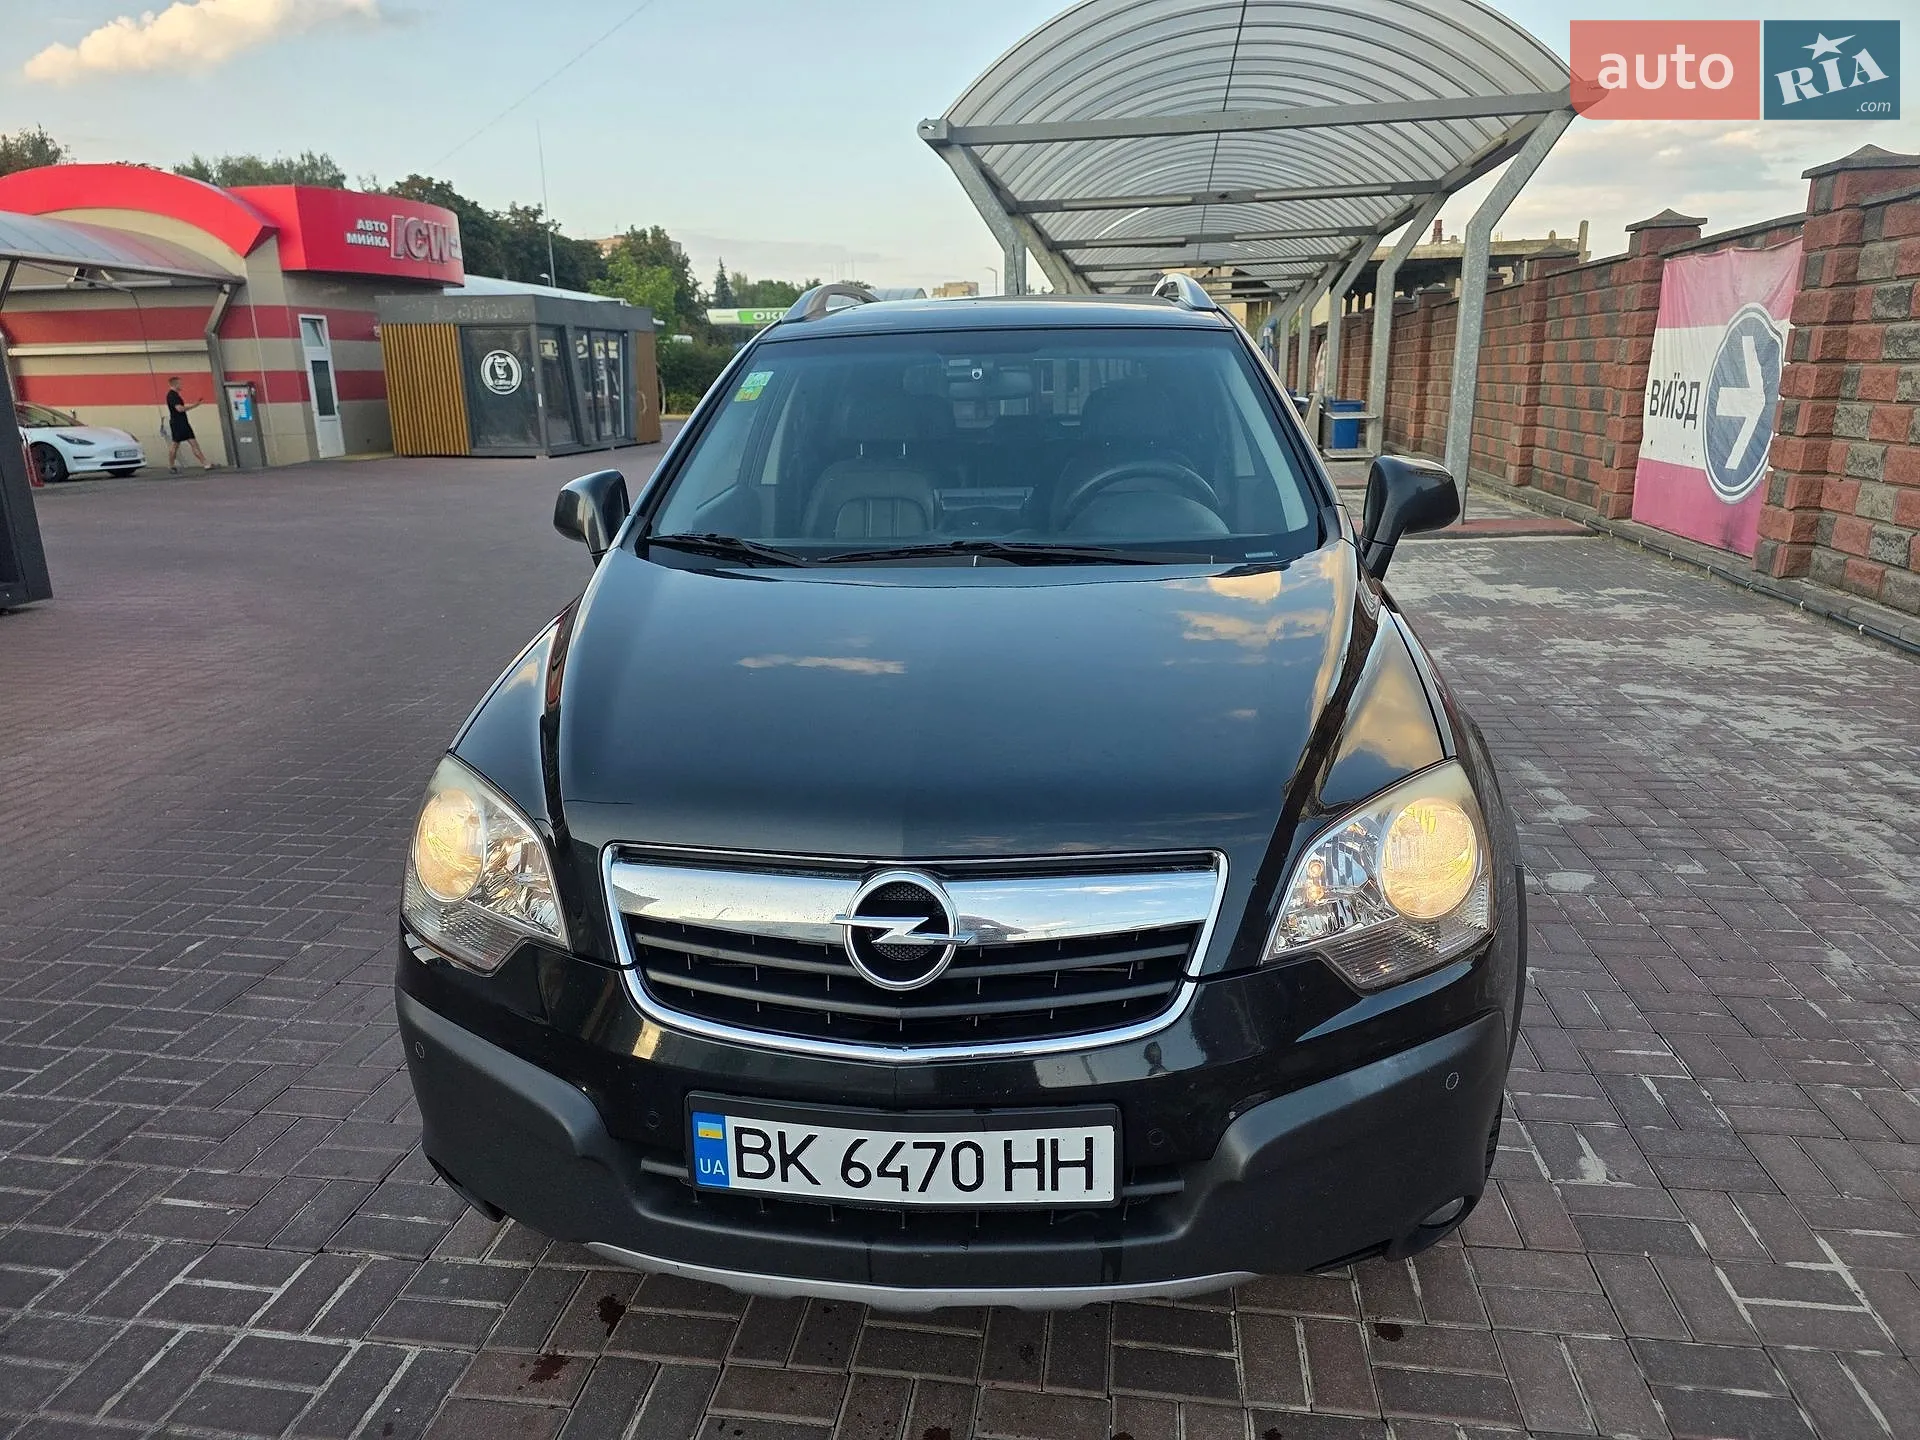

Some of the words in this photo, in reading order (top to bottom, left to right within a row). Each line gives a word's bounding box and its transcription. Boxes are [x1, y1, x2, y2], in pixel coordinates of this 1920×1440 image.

[356, 219, 388, 233] АВТО
[346, 232, 390, 248] МИЙКА
[1649, 373, 1700, 429] ВИЇЗД
[700, 1159, 725, 1176] UA
[733, 1126, 821, 1186] BK
[840, 1138, 984, 1193] 6470
[1004, 1136, 1094, 1193] HH
